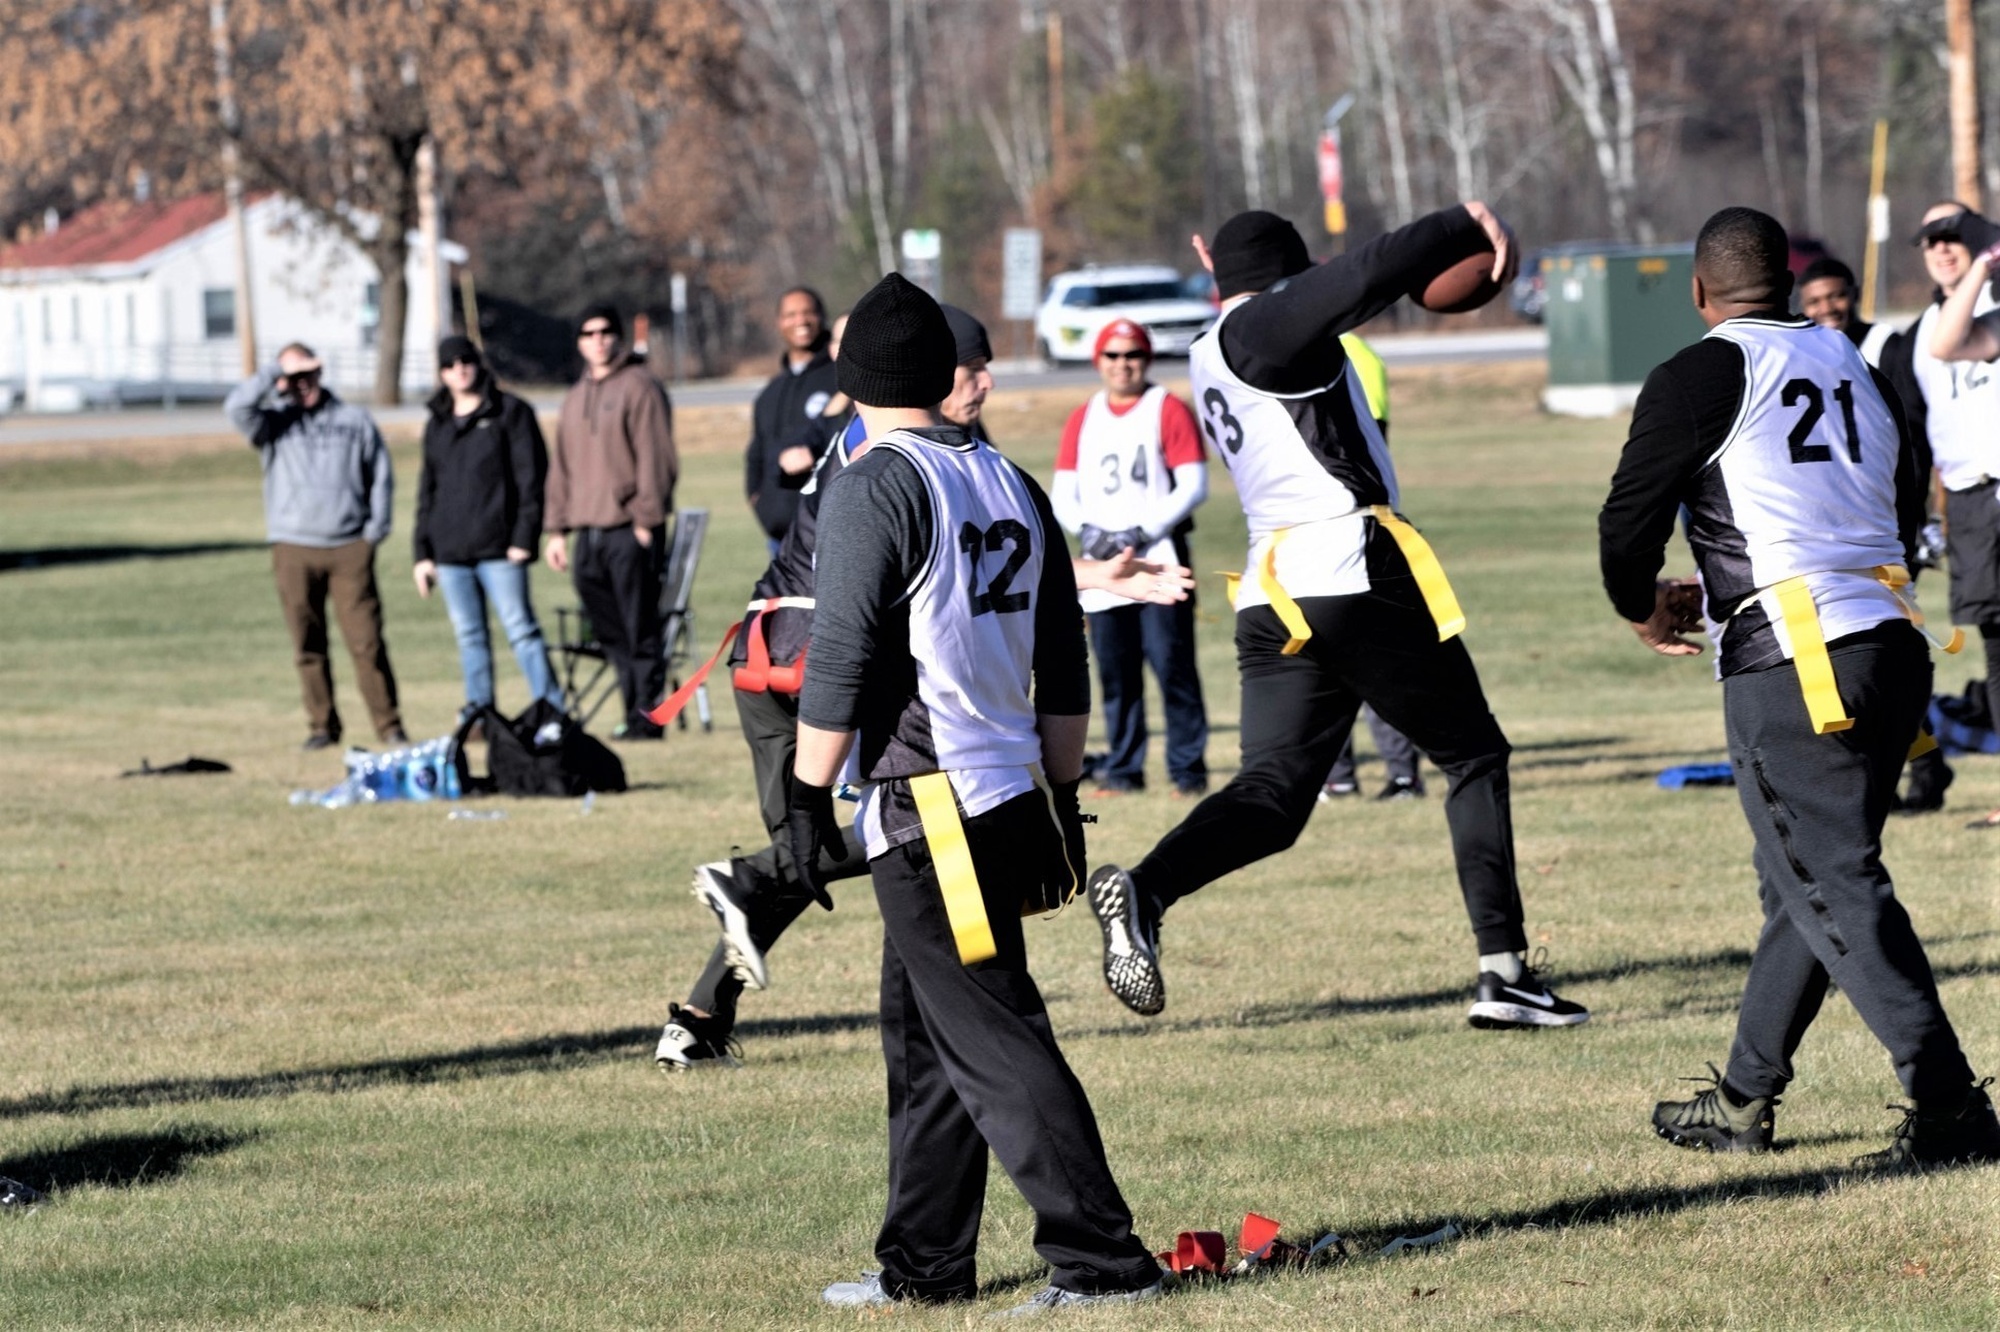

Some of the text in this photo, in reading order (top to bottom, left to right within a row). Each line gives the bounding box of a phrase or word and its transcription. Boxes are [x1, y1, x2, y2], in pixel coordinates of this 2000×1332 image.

[1203, 386, 1244, 470] 3
[1780, 377, 1863, 464] 21
[1100, 445, 1148, 495] 34
[959, 518, 1032, 618] 22
